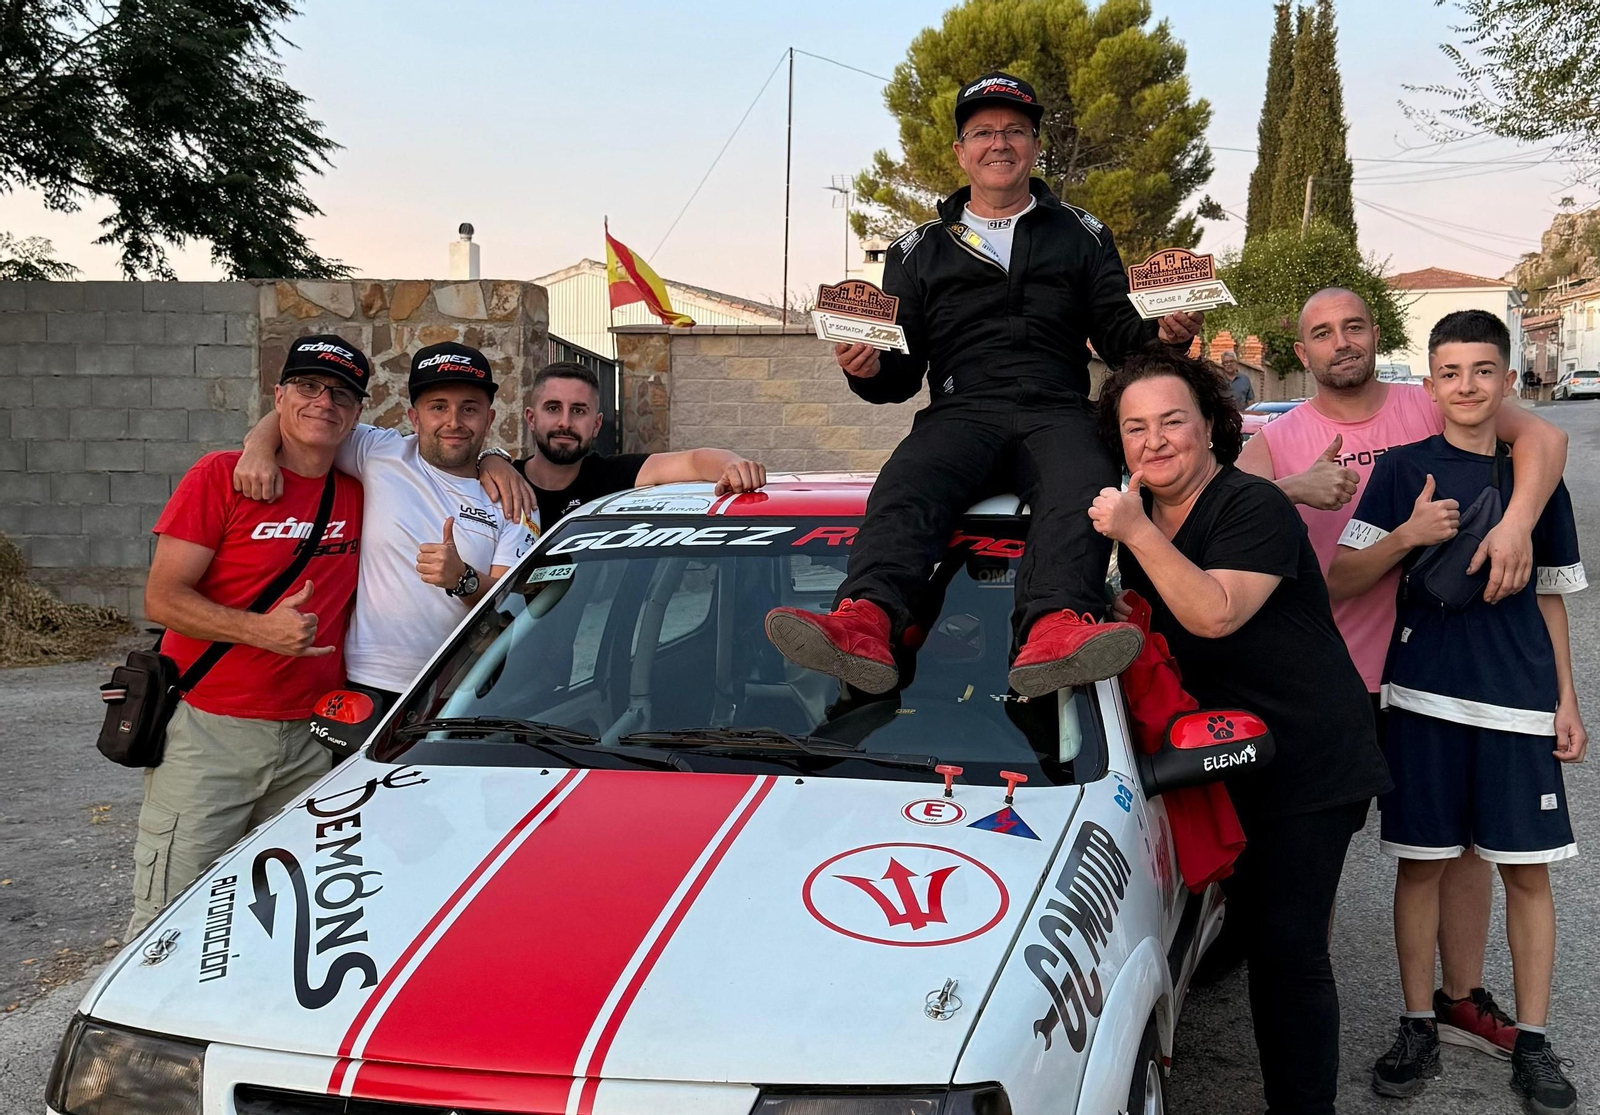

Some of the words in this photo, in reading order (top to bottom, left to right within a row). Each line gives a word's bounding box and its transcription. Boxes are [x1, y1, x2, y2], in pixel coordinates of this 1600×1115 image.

[983, 85, 1033, 103] Racing
[835, 324, 864, 334] SCRATCH
[297, 342, 354, 360] GÓMEZ
[318, 352, 364, 377] Racing
[418, 354, 472, 369] GÓMEZ
[437, 363, 485, 378] Racing
[545, 523, 797, 556] GÓMEZ
[548, 567, 572, 577] 423
[978, 568, 1016, 584] OMP
[1219, 730, 1227, 738] R
[1203, 750, 1248, 772] ELENA
[924, 803, 945, 818] E
